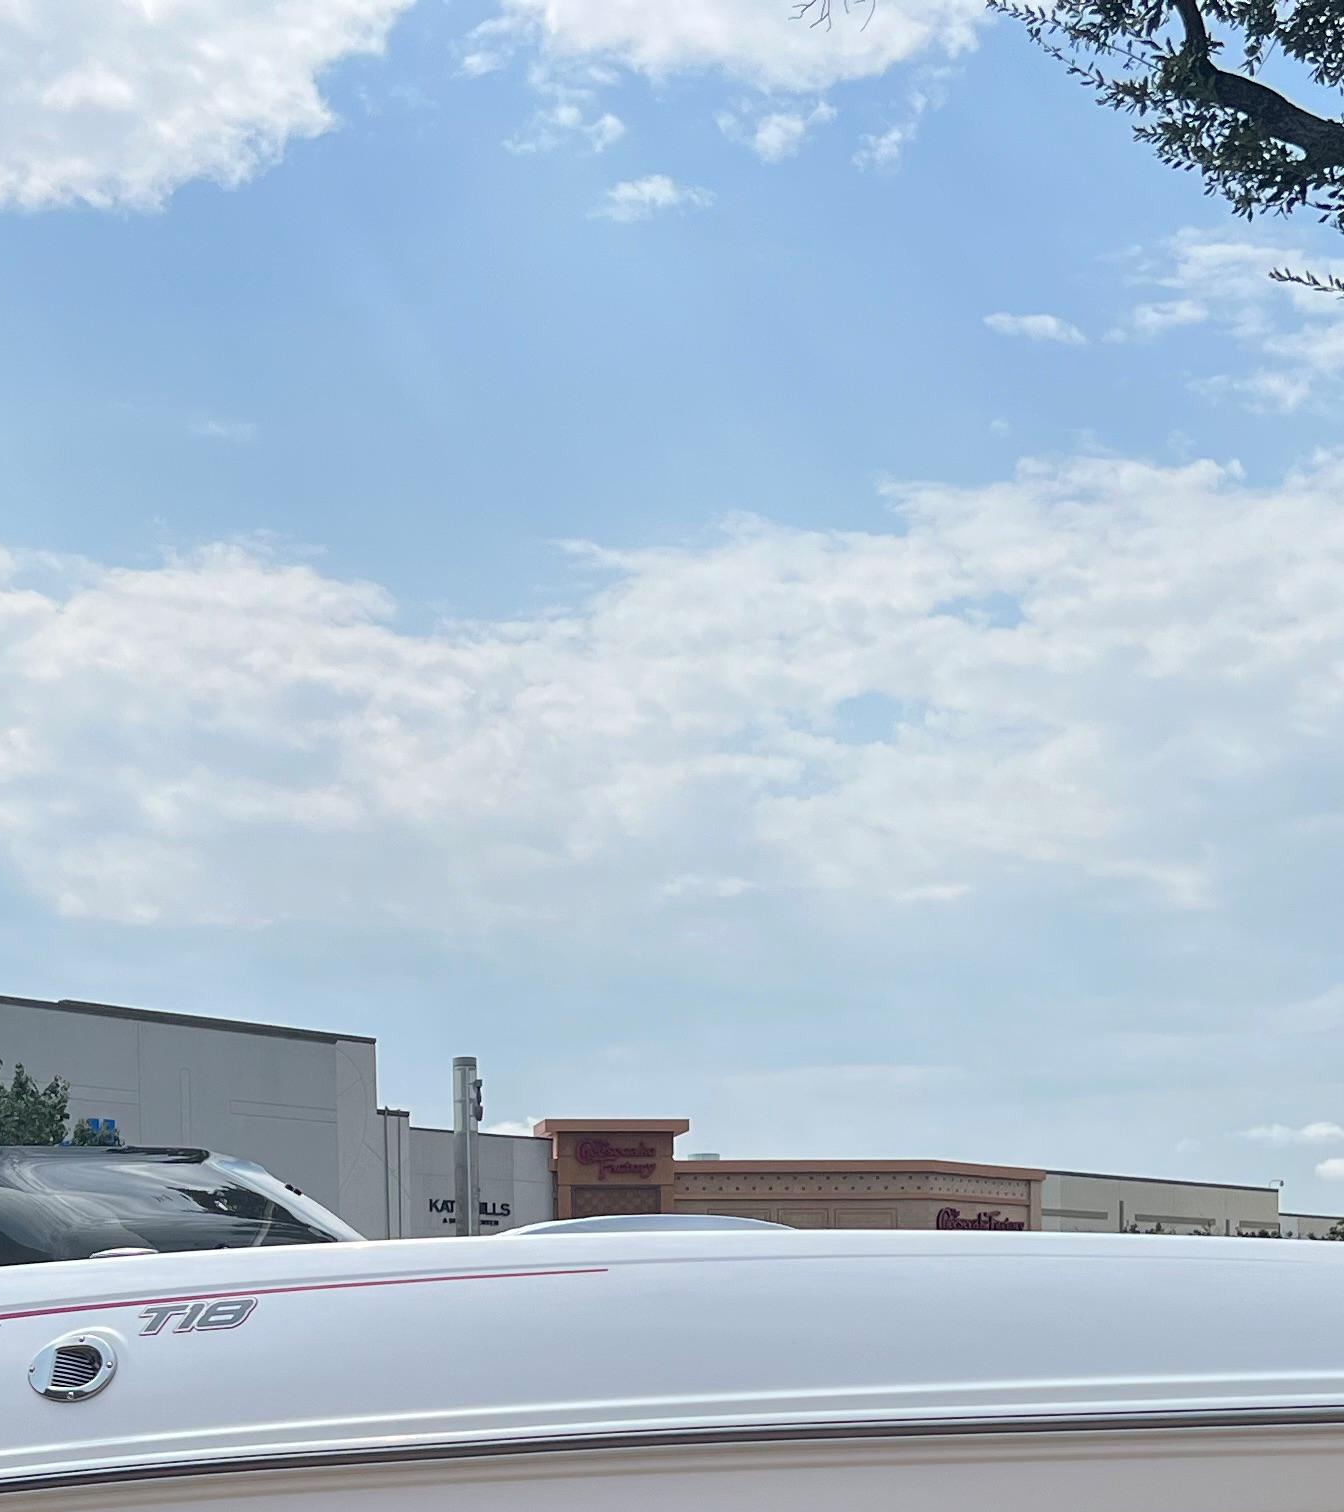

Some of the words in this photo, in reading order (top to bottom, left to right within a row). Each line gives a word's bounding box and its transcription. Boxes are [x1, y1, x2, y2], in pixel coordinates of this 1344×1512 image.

[429, 1199, 455, 1213] KAT
[478, 1202, 511, 1216] ILLS
[138, 1297, 258, 1336] T18
